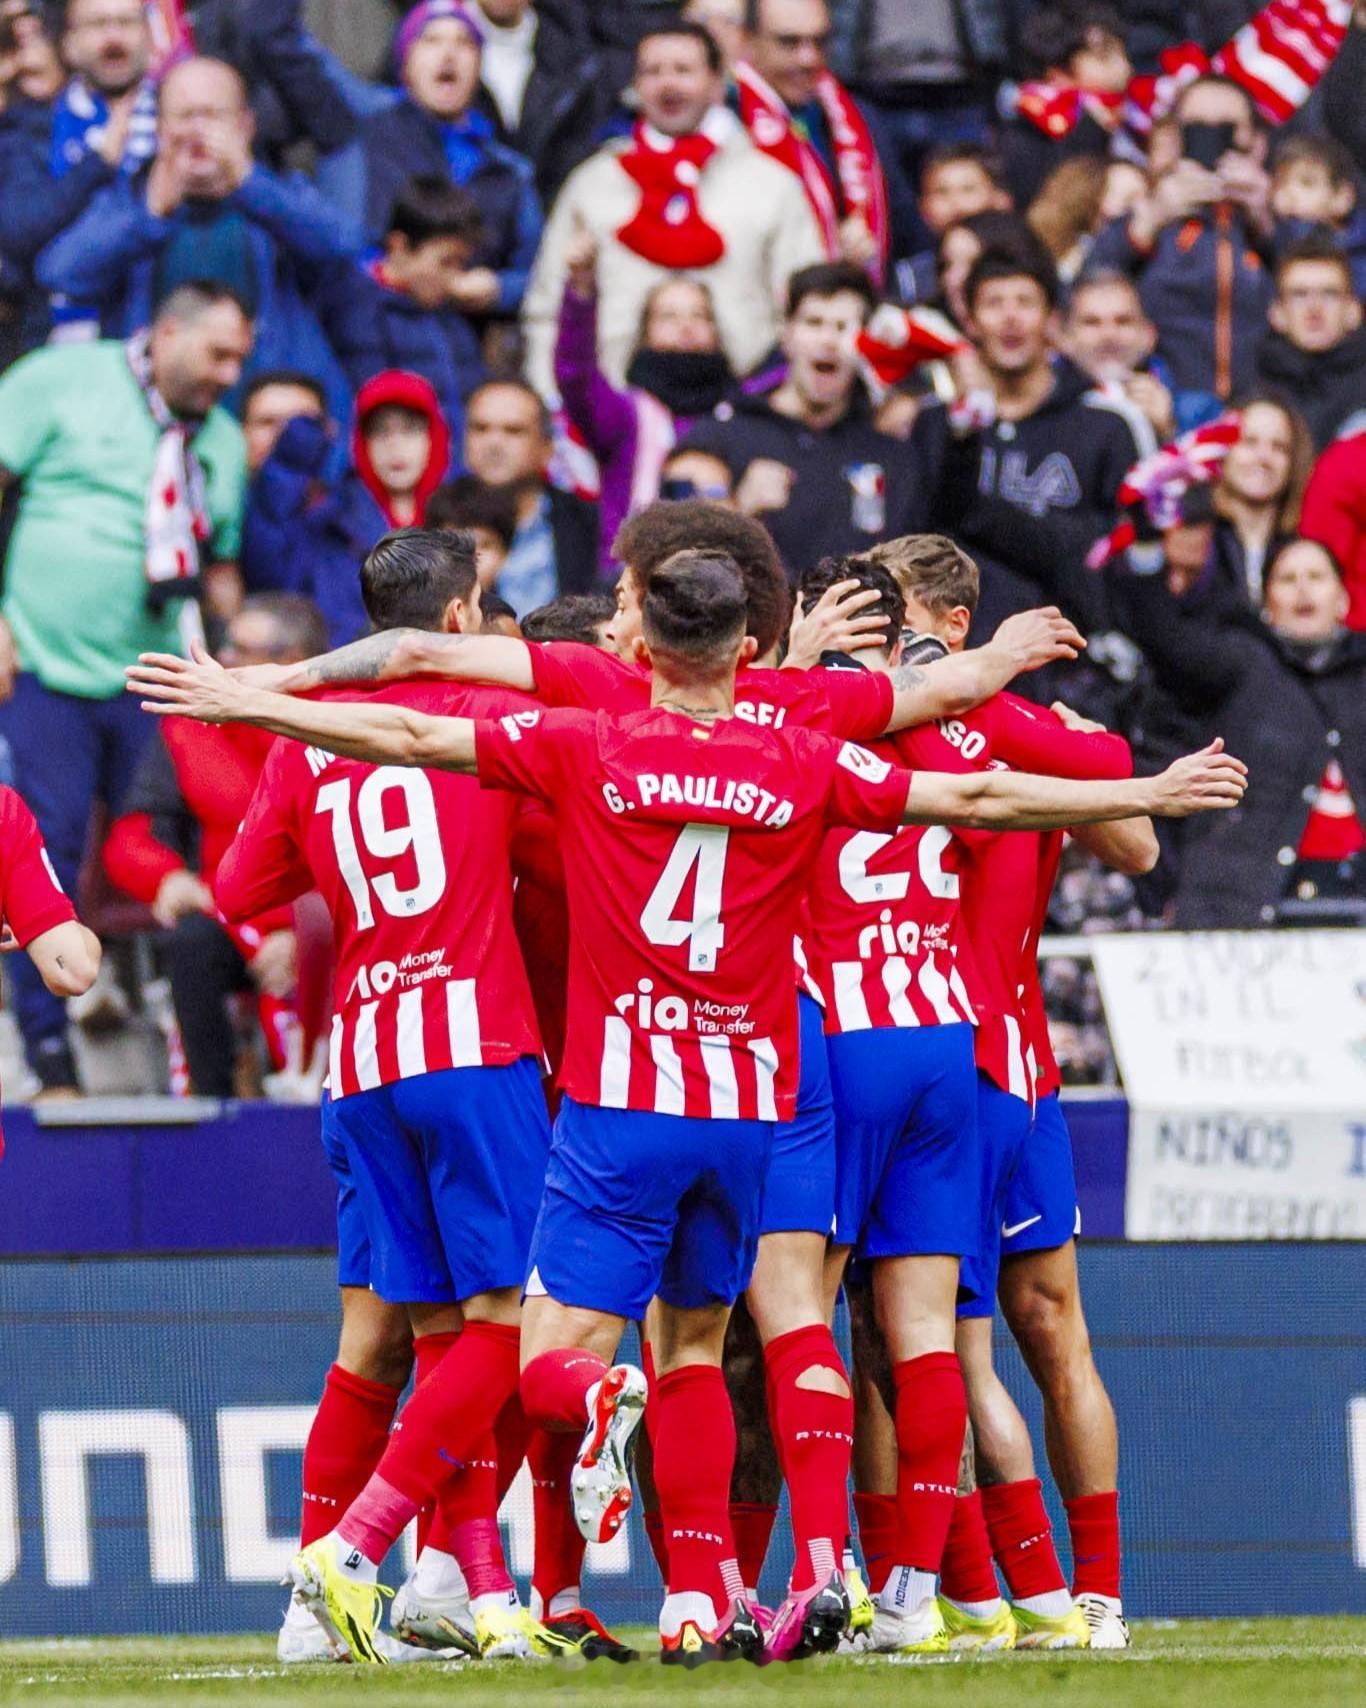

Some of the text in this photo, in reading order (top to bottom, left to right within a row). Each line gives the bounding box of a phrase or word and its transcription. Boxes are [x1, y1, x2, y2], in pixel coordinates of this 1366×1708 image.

[602, 773, 794, 830] G. PAULISTA
[315, 765, 446, 931] 19
[640, 822, 730, 972] 4
[400, 947, 446, 970] Money
[858, 907, 918, 959] ria
[398, 964, 454, 988] Transfer
[614, 978, 689, 1031] ria
[694, 1000, 750, 1018] Money
[694, 1017, 755, 1035] Transfer
